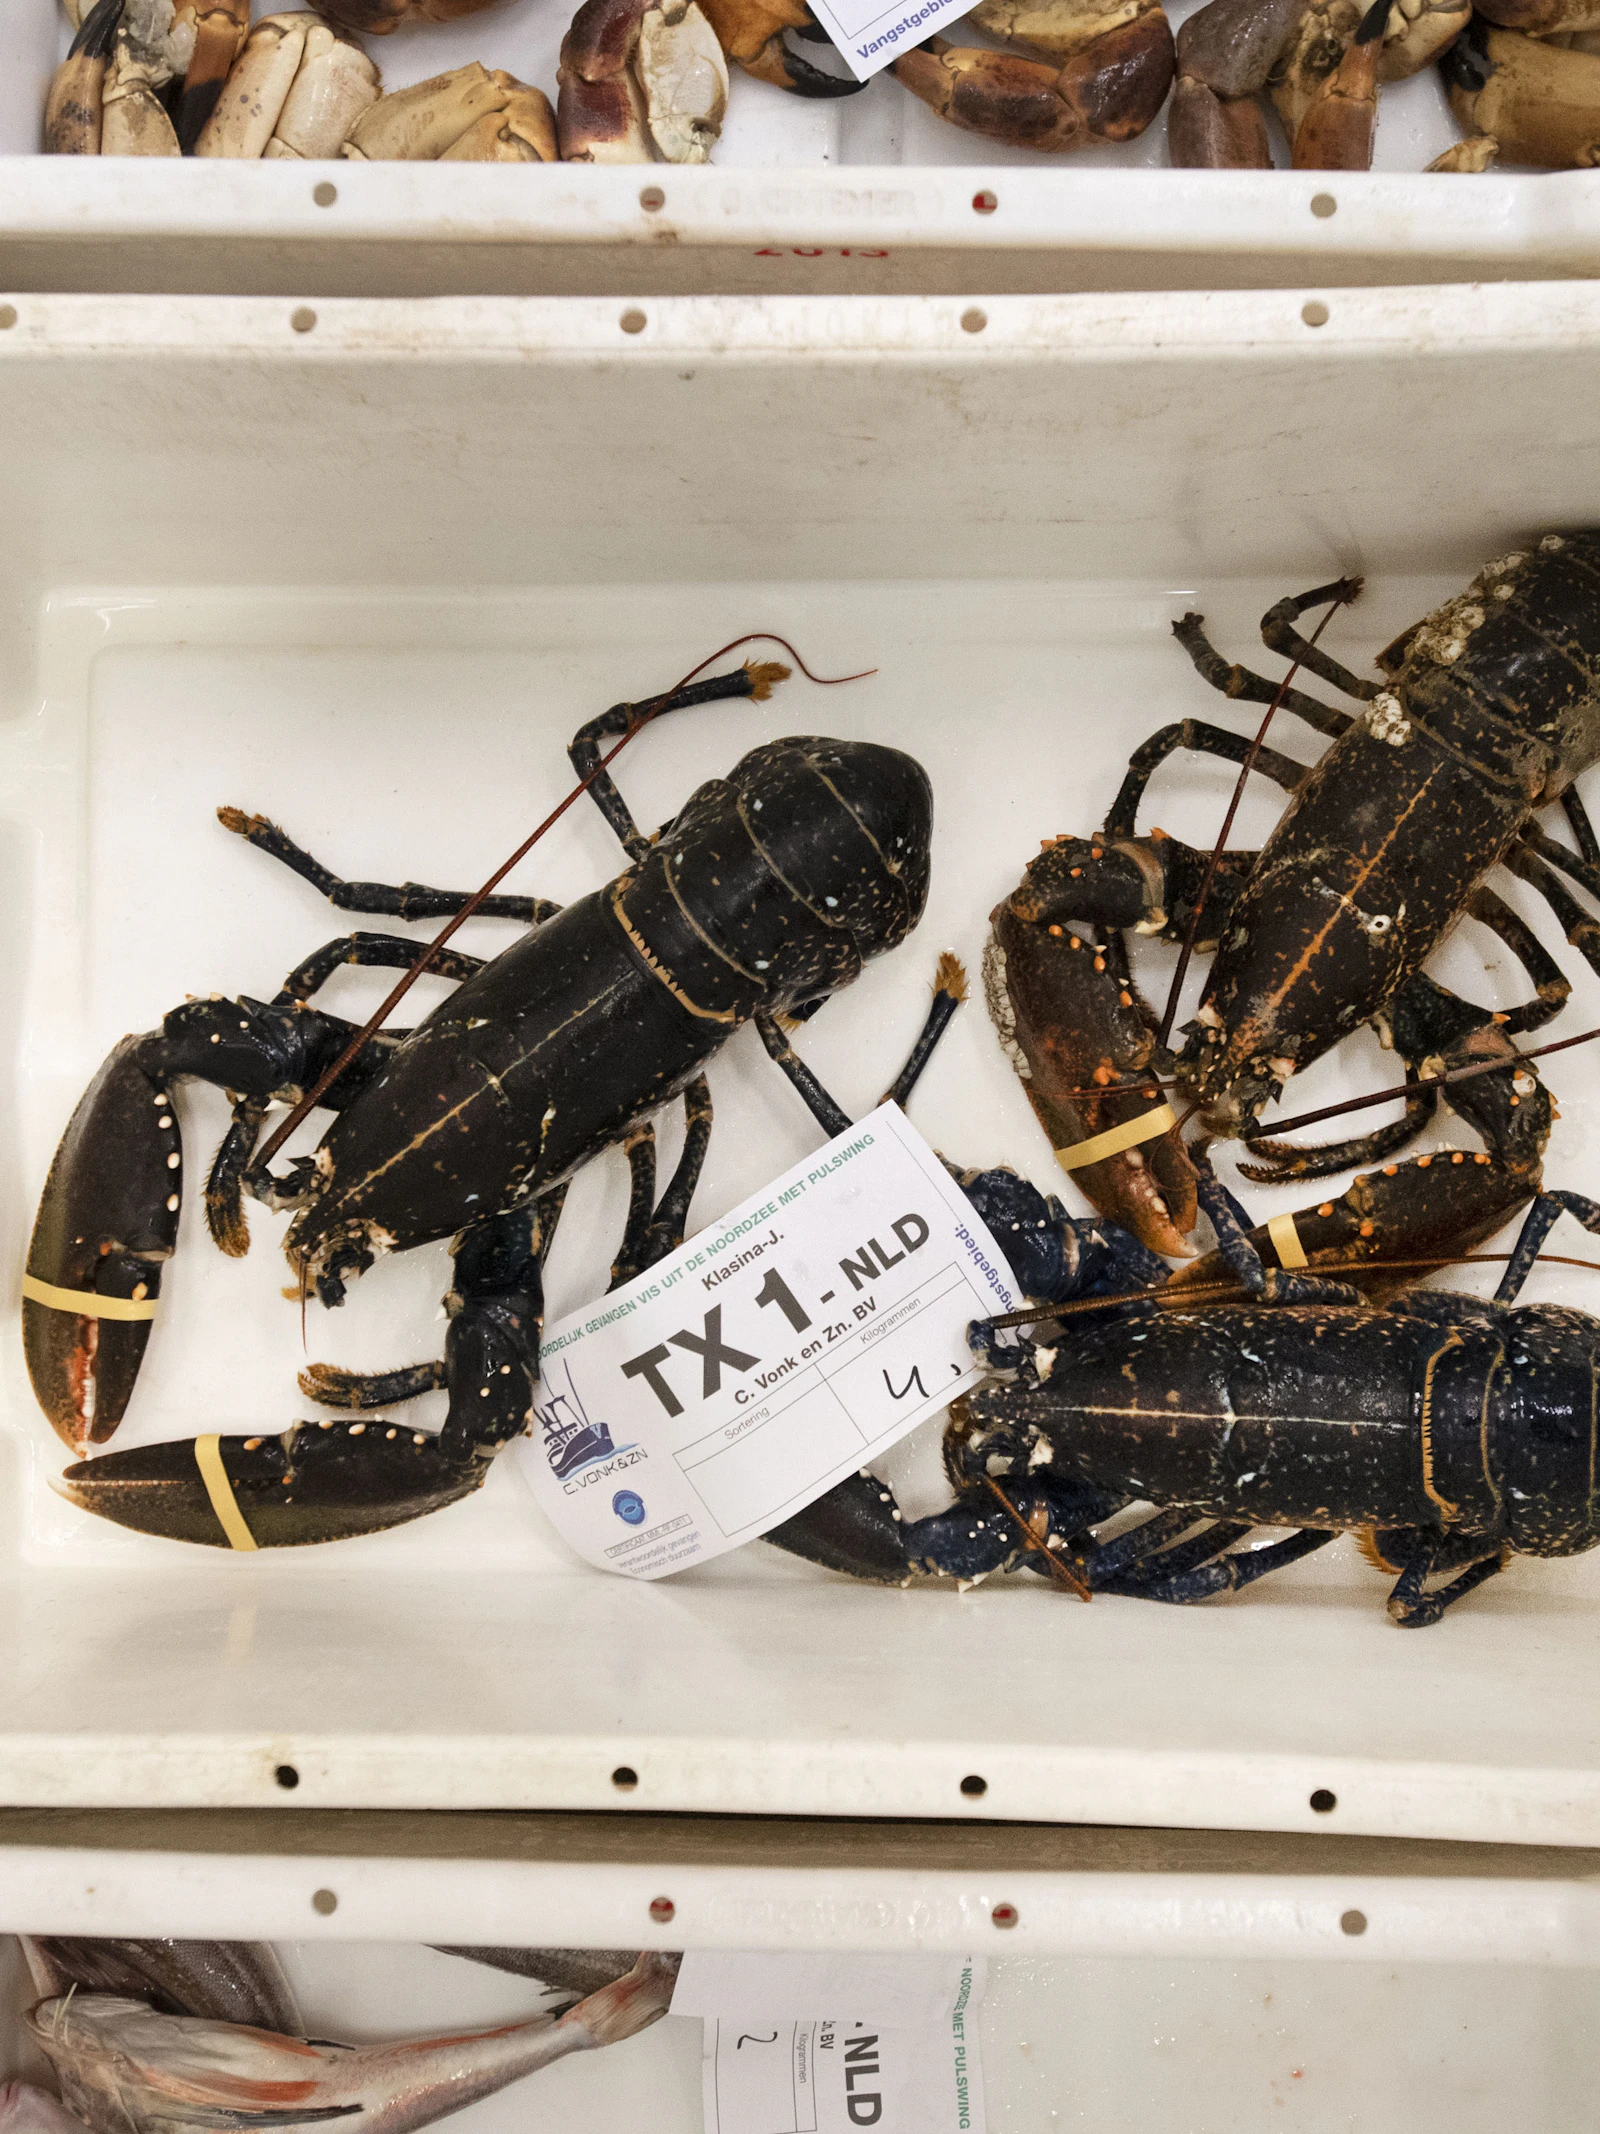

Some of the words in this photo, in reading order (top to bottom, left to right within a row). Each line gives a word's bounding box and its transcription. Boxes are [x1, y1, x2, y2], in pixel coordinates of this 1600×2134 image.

[585, 1300, 637, 1334] GEVANGEN
[636, 1285, 661, 1305] VIS
[661, 1267, 685, 1289] UIT
[684, 1253, 706, 1272] DE
[705, 1202, 778, 1257] NOORDZEE
[777, 1180, 807, 1206] MET
[807, 1133, 875, 1185] PULSWING
[701, 1229, 784, 1291] Klasina-J.
[954, 1223, 1015, 1314] ngstgebied:
[620, 1303, 762, 1418] TX
[754, 1267, 813, 1334] 1
[838, 1213, 930, 1292] NLD
[734, 1389, 755, 1404] C.
[754, 1356, 799, 1390] Vonk
[801, 1339, 822, 1359] en
[822, 1321, 853, 1343] Zn.
[852, 1296, 877, 1321] BV
[860, 1298, 921, 1345] Kilogrammen
[724, 1406, 770, 1440] Sortering
[797, 2033, 808, 2083] Kilogrammen
[820, 2033, 835, 2049] BV
[952, 2012, 965, 2041] MET
[844, 2034, 883, 2126] NLD
[954, 2046, 971, 2130] PULSWING
